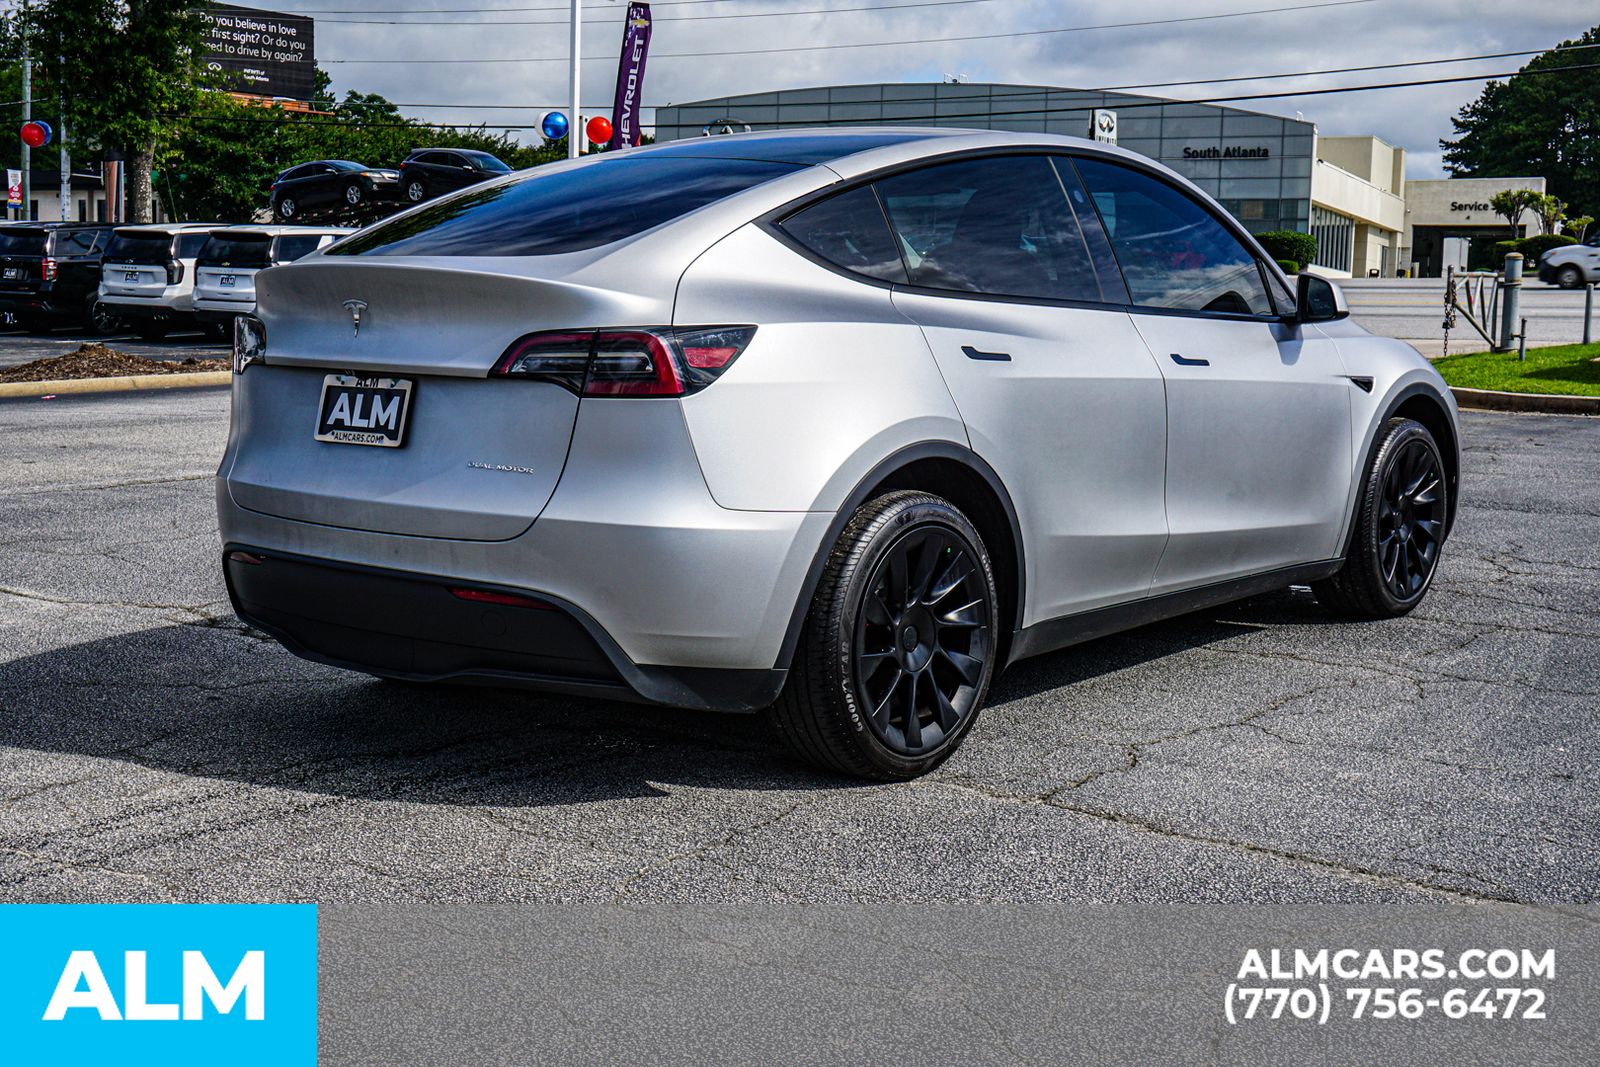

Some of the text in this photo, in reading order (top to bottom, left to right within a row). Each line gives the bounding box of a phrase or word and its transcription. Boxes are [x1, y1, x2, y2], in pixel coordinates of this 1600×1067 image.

[200, 12, 297, 36] Do you believe in love
[211, 27, 231, 40] first
[232, 31, 260, 44] sight?
[262, 34, 274, 45] Or
[275, 39, 287, 47] do
[289, 41, 306, 50] you
[225, 43, 235, 53] to
[237, 45, 259, 57] drive
[261, 47, 272, 60] by
[274, 52, 303, 63] again?
[621, 34, 644, 150] HEVROLET
[1183, 146, 1269, 158] South Atlanta
[1450, 201, 1489, 212] Service
[355, 377, 379, 388] ALM
[326, 392, 400, 430] ALM
[333, 432, 382, 444] ALMCARS.COM
[468, 461, 534, 474] DUAL MOTOR
